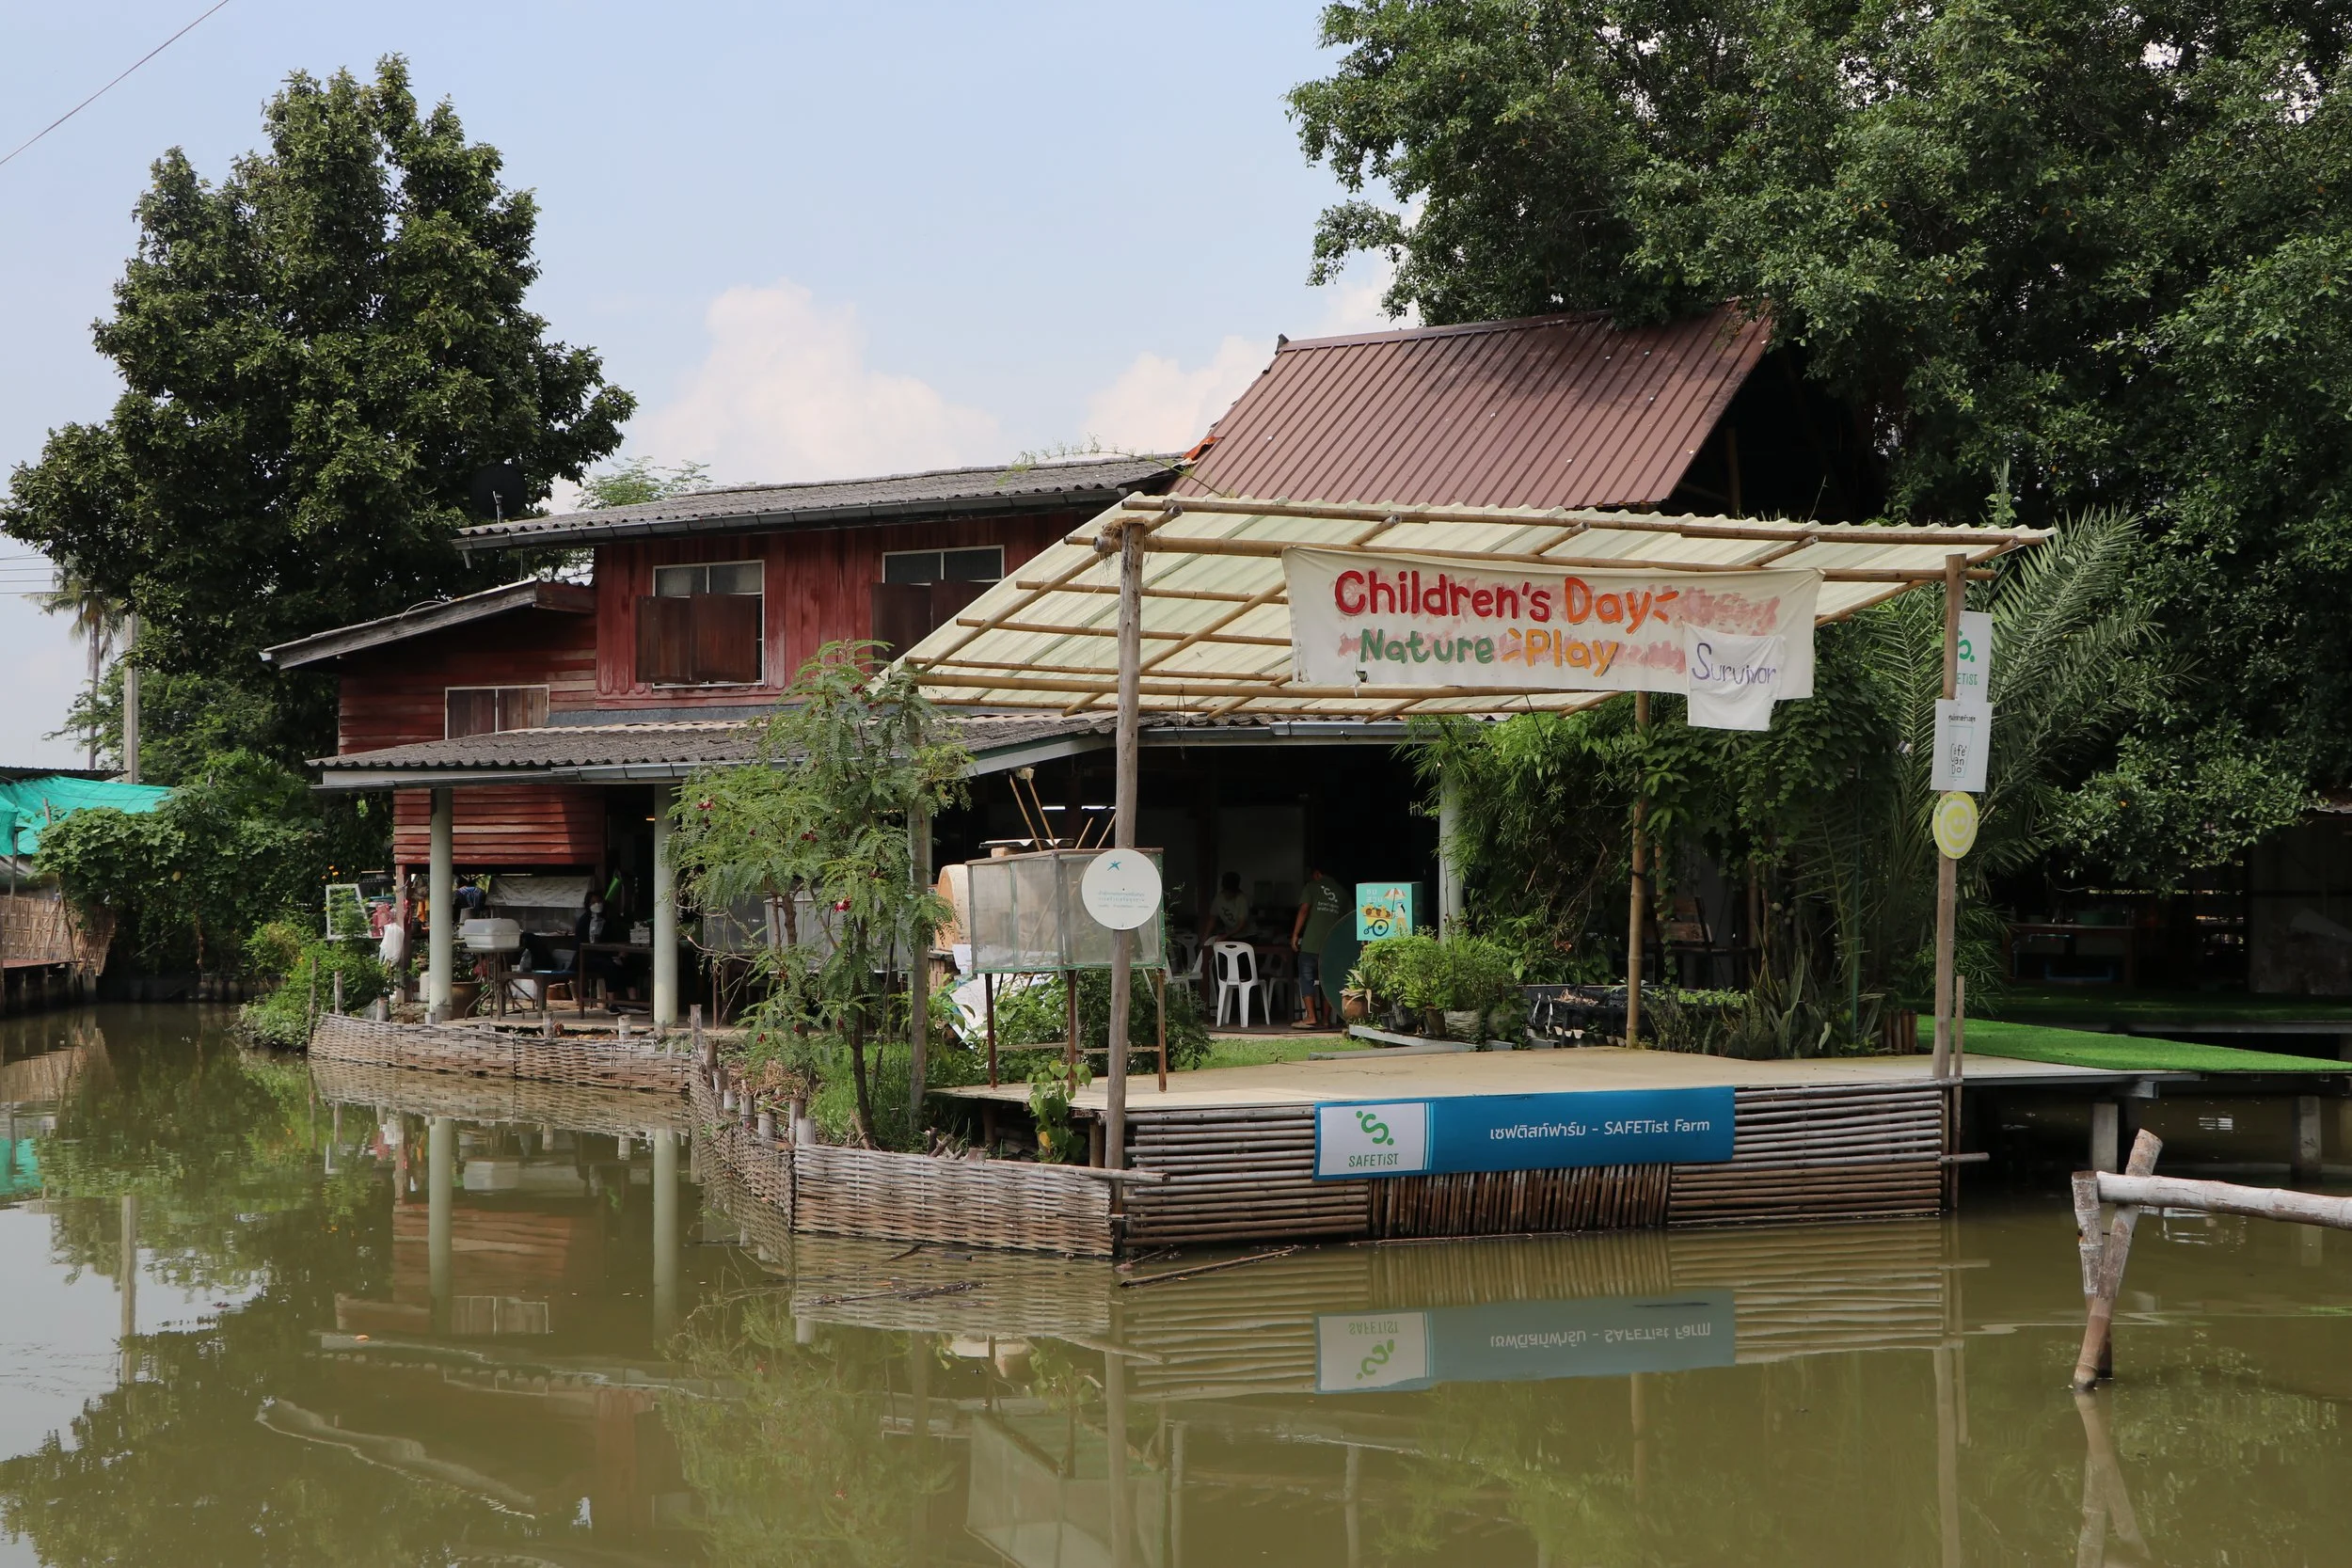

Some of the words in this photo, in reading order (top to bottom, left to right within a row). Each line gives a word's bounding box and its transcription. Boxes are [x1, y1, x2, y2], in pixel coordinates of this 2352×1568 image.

[1334, 569, 1552, 623] Children's
[1359, 628, 1494, 664] Nature
[1524, 628, 1619, 677] Play
[1692, 642, 1776, 685] Survivor
[1604, 1120, 1669, 1135] SAFETist
[1675, 1118, 1710, 1132] Farm
